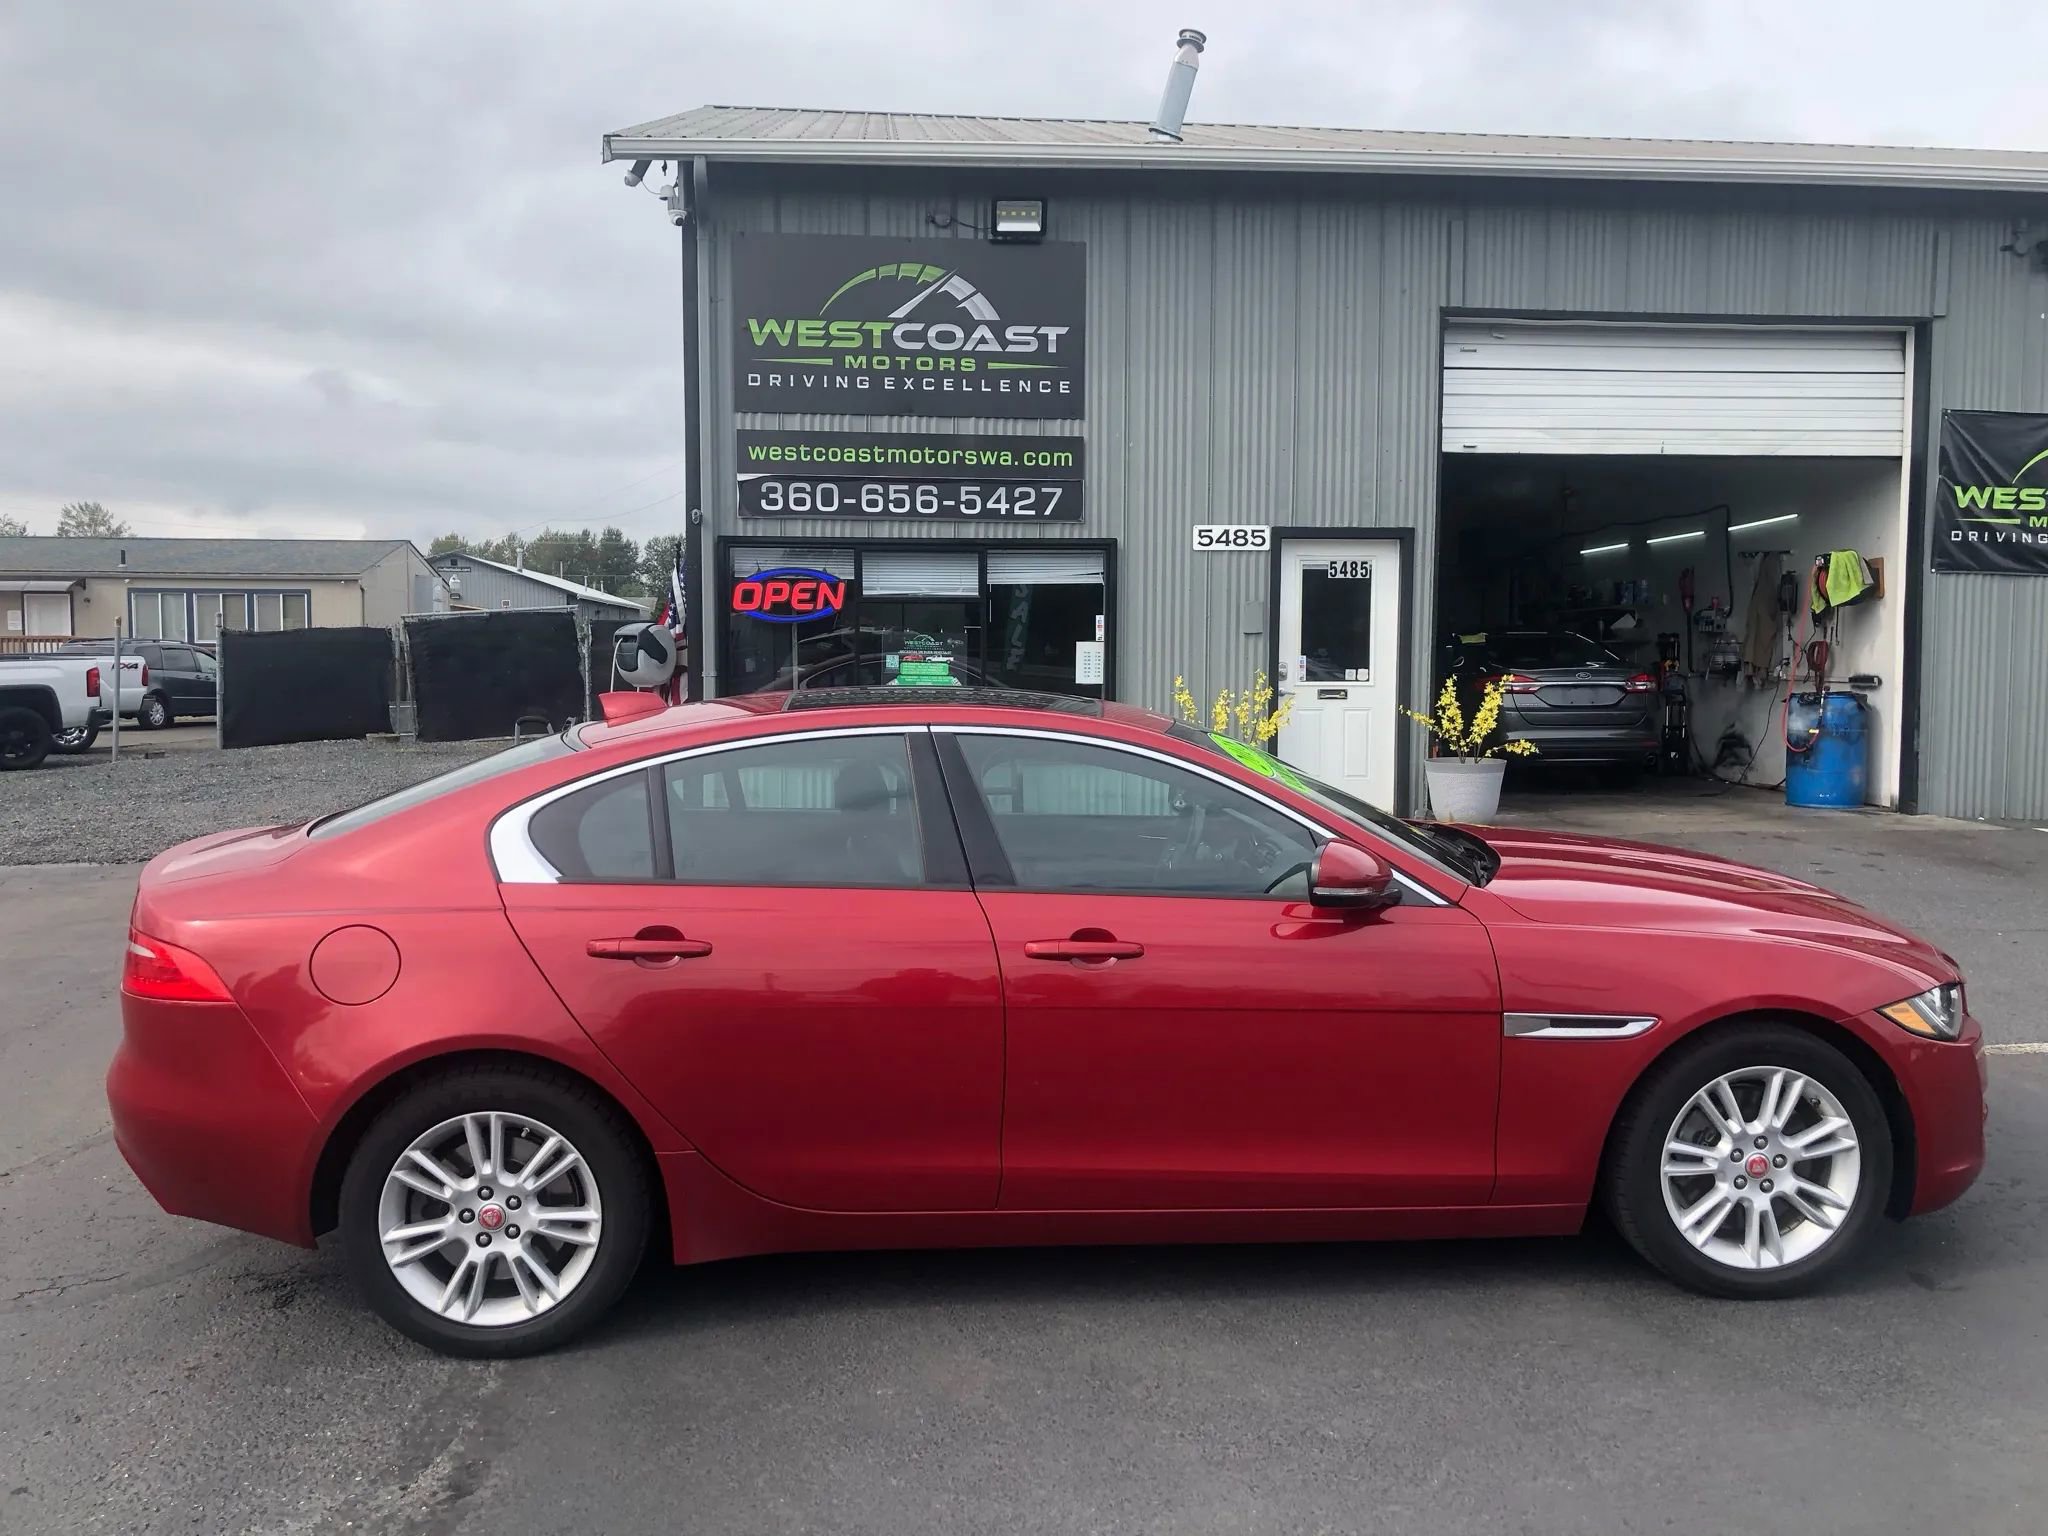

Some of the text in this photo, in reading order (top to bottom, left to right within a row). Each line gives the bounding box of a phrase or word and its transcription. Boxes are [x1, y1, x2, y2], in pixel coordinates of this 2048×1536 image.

[747, 318, 1070, 353] WESTCOAST
[845, 355, 976, 372] MOTORS
[748, 373, 1071, 393] DRIVING EXCELLENCE
[748, 444, 1073, 467] westcoastmotorswa.com
[760, 482, 1063, 516] 360-656-5427
[1954, 485, 2048, 510] WES
[1197, 529, 1266, 547] 5485
[1329, 561, 1369, 578] 5485
[732, 582, 846, 611] OPEN
